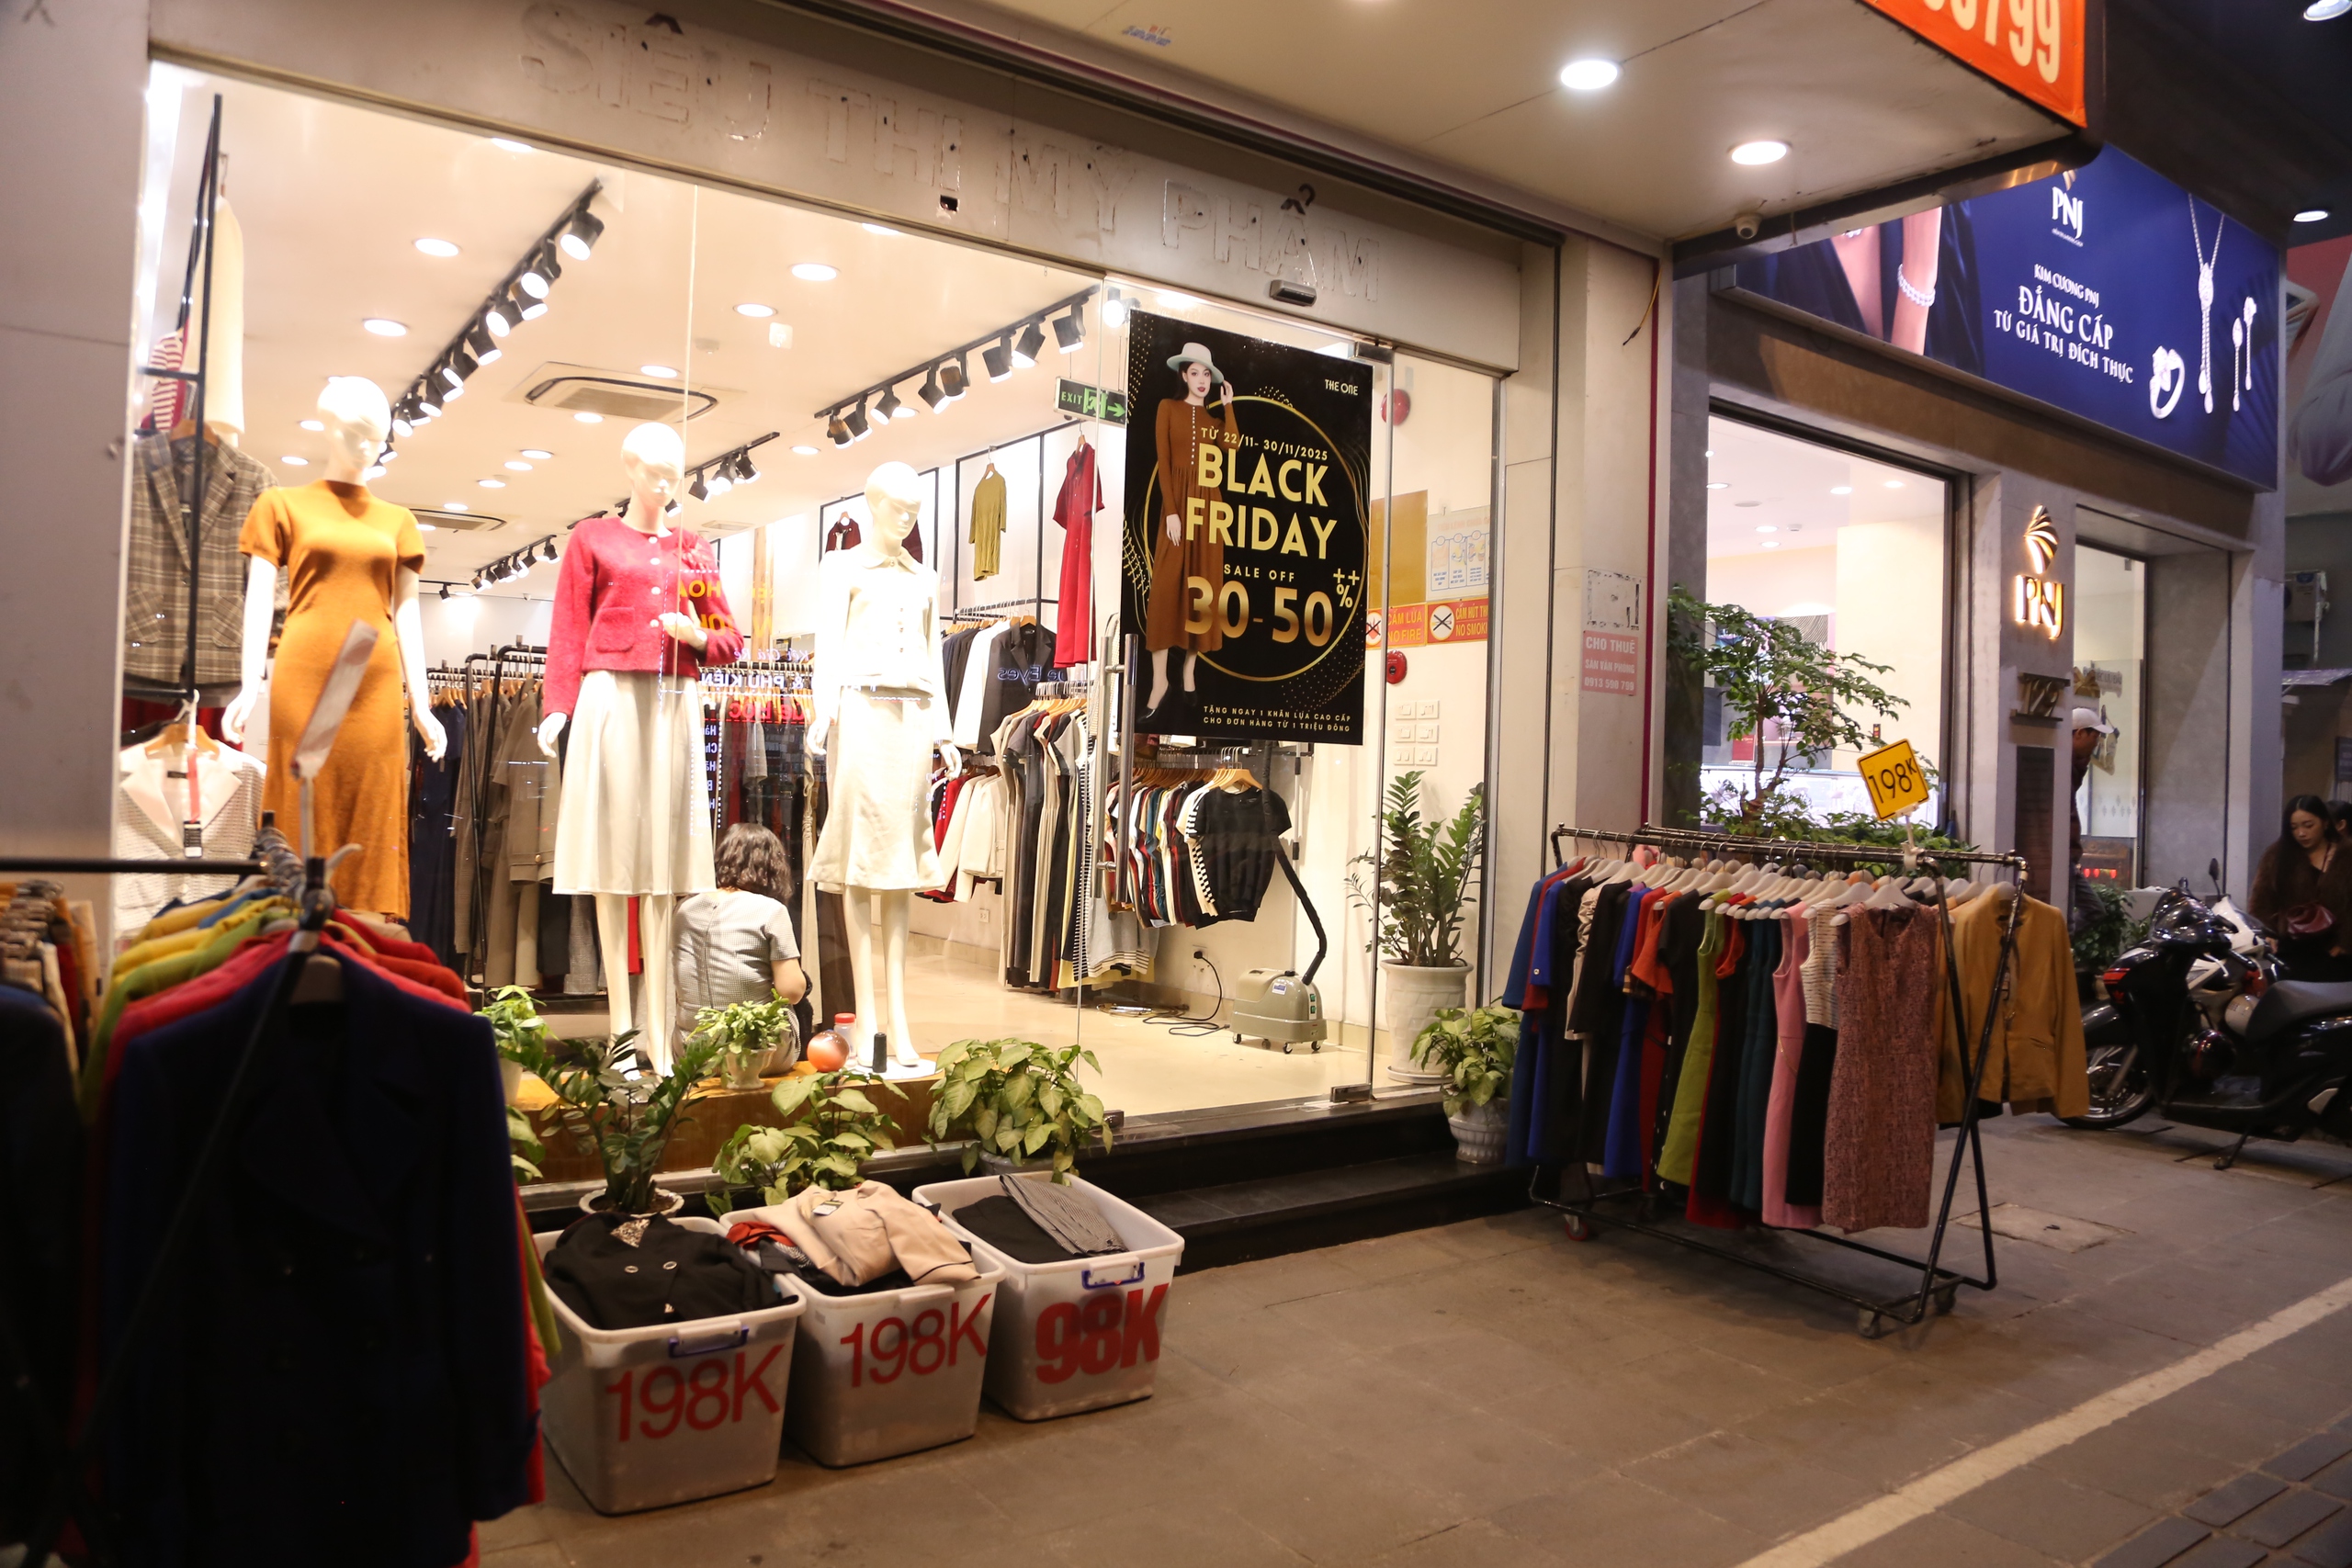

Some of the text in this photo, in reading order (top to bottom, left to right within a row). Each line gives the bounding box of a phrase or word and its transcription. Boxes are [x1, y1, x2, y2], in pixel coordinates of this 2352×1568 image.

[2052, 186, 2084, 239] PNJ
[2033, 264, 2052, 284] KIM
[2084, 288, 2099, 310] PNJ
[2018, 285, 2113, 350] ĐẲNG CẤP
[2016, 321, 2040, 344] GIÁ
[2043, 331, 2064, 357] TRỊ
[2068, 342, 2098, 369] ĐÍCH
[2102, 356, 2133, 384] THỰC
[1061, 391, 1082, 405] EXIT
[1324, 378, 1359, 396] THE ONE
[1201, 425, 1219, 440] TỪ
[1263, 440, 1328, 460] 30/11/2025
[1198, 443, 1329, 506] BLACK
[1186, 497, 1338, 559] FRIDAY
[1224, 564, 1295, 582] SALE OFF
[1387, 607, 1423, 626] CẤM LỬA
[1455, 603, 1467, 620] CẤM
[1468, 604, 1479, 619] HÚT
[2015, 574, 2064, 640] PNJ
[1387, 628, 1422, 642] NO FIRE
[1455, 626, 1465, 637] NO
[1585, 637, 1607, 650] CHO
[1584, 676, 1603, 687] 0913
[1621, 681, 1634, 691] 799
[1204, 705, 1227, 715] TẶNG
[1268, 709, 1290, 718] KHĂN
[1314, 713, 1331, 721] CAO
[1335, 714, 1351, 722] CẤP
[1227, 717, 1245, 726] ĐƠN
[1250, 718, 1272, 728] HÀNG
[1277, 720, 1289, 728] TỪ
[1300, 722, 1323, 731] TRIỆU
[1868, 758, 1917, 804] 198K
[841, 1293, 992, 1388] 198K
[1035, 1282, 1170, 1384] 98K
[605, 1344, 786, 1442] 198K
